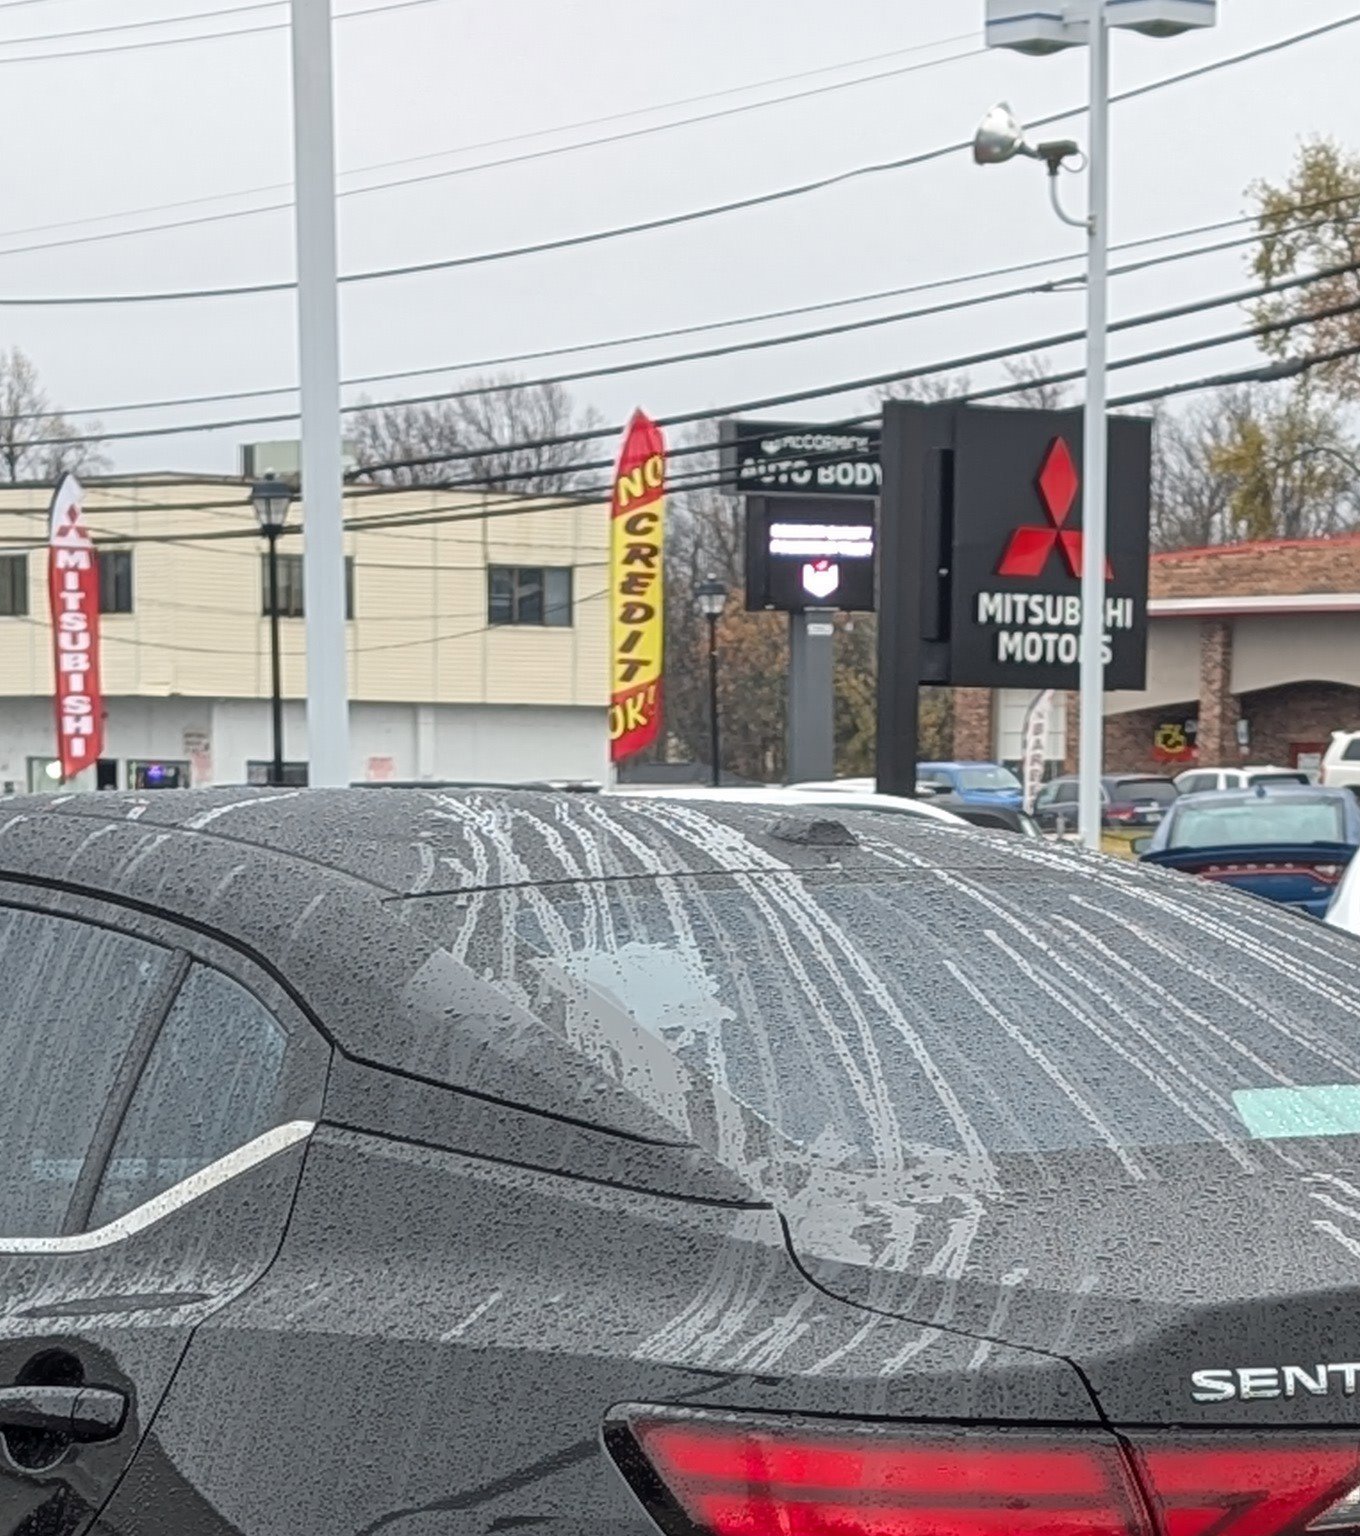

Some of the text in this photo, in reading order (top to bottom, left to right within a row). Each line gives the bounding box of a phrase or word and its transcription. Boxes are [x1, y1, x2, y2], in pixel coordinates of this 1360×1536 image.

[618, 455, 664, 507] NO
[619, 512, 658, 684] CREDIT
[978, 592, 1133, 629] MITSUBHI
[56, 550, 93, 757] MITSUBISHI
[998, 631, 1113, 664] MOTOS
